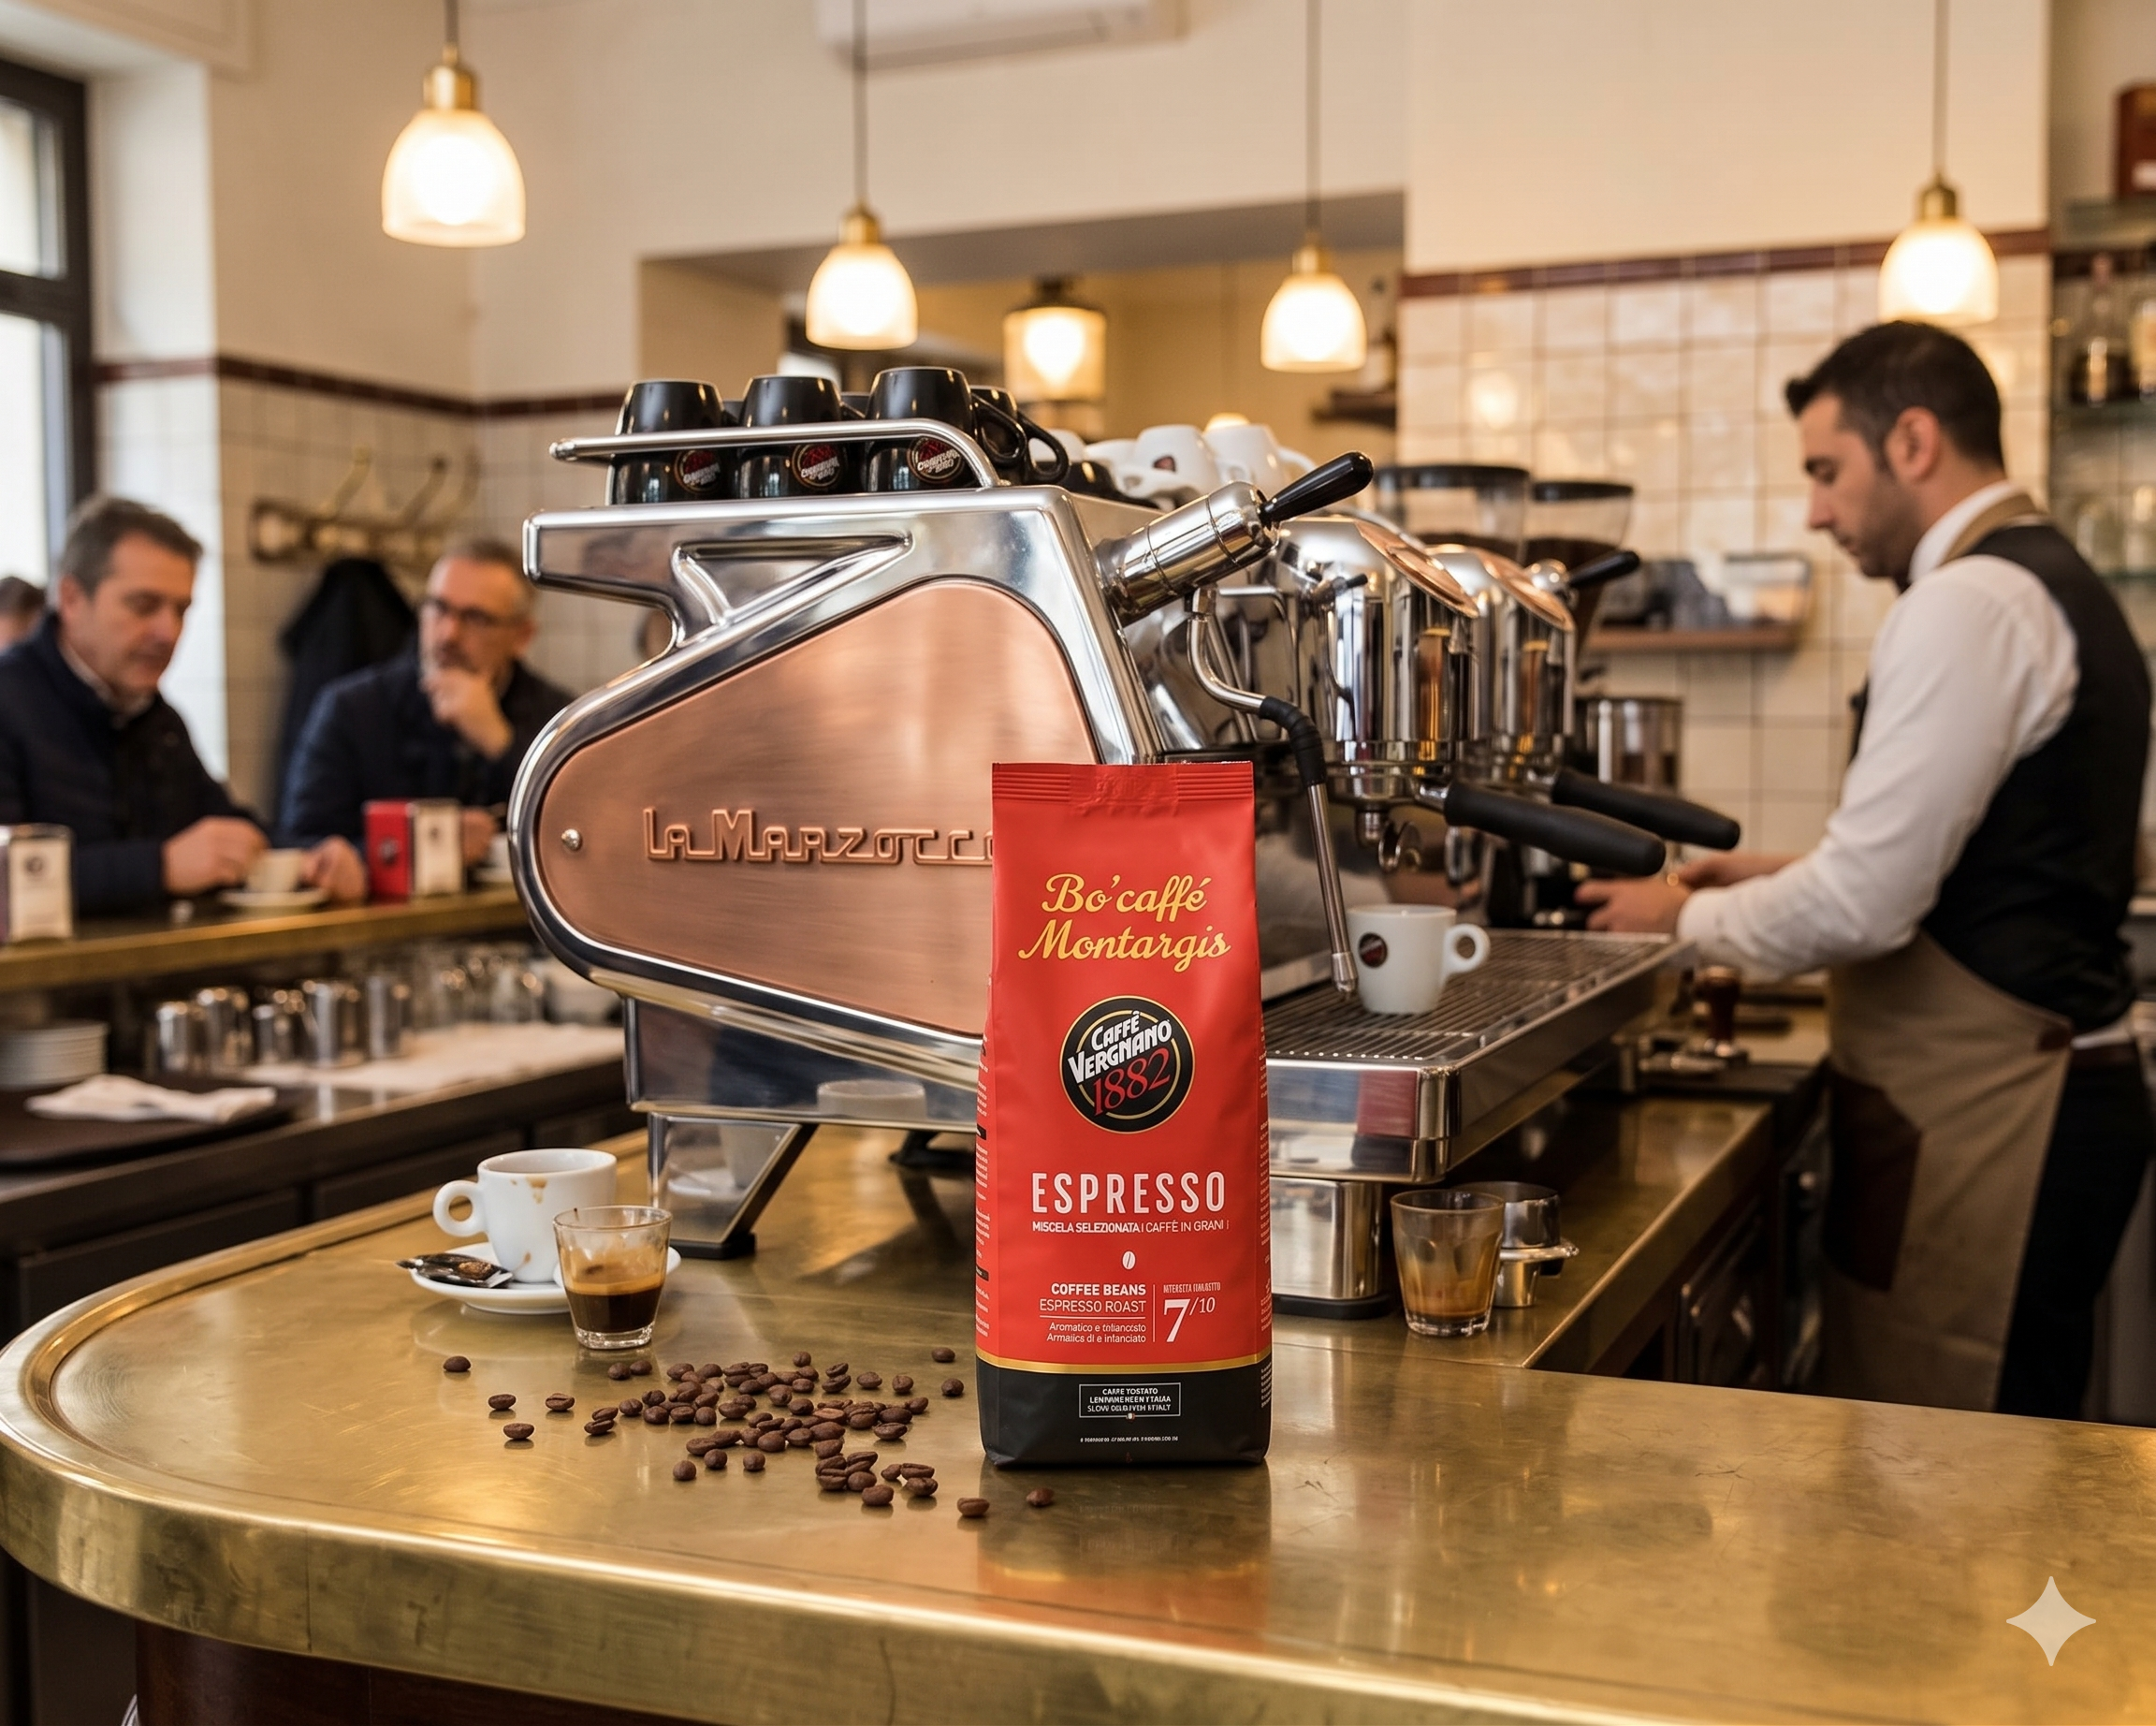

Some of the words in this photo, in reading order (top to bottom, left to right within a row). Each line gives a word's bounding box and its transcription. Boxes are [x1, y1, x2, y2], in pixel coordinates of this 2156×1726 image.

[1017, 918, 1231, 973] Montargis
[1068, 1019, 1173, 1084] VERGNANO
[1094, 1047, 1171, 1116] 1882
[1031, 1171, 1226, 1214] ESPRESSO
[1032, 1221, 1074, 1233] MISCELA
[1075, 1221, 1140, 1234] SELEZIONATA
[1181, 1221, 1192, 1233] IN
[1193, 1219, 1224, 1231] GRANI
[1051, 1282, 1100, 1296] COFFEE
[1102, 1283, 1146, 1296] BEANS
[1039, 1298, 1102, 1313] ESPRESSO
[1104, 1300, 1146, 1313] ROAST
[1049, 1322, 1093, 1332] Aromatico
